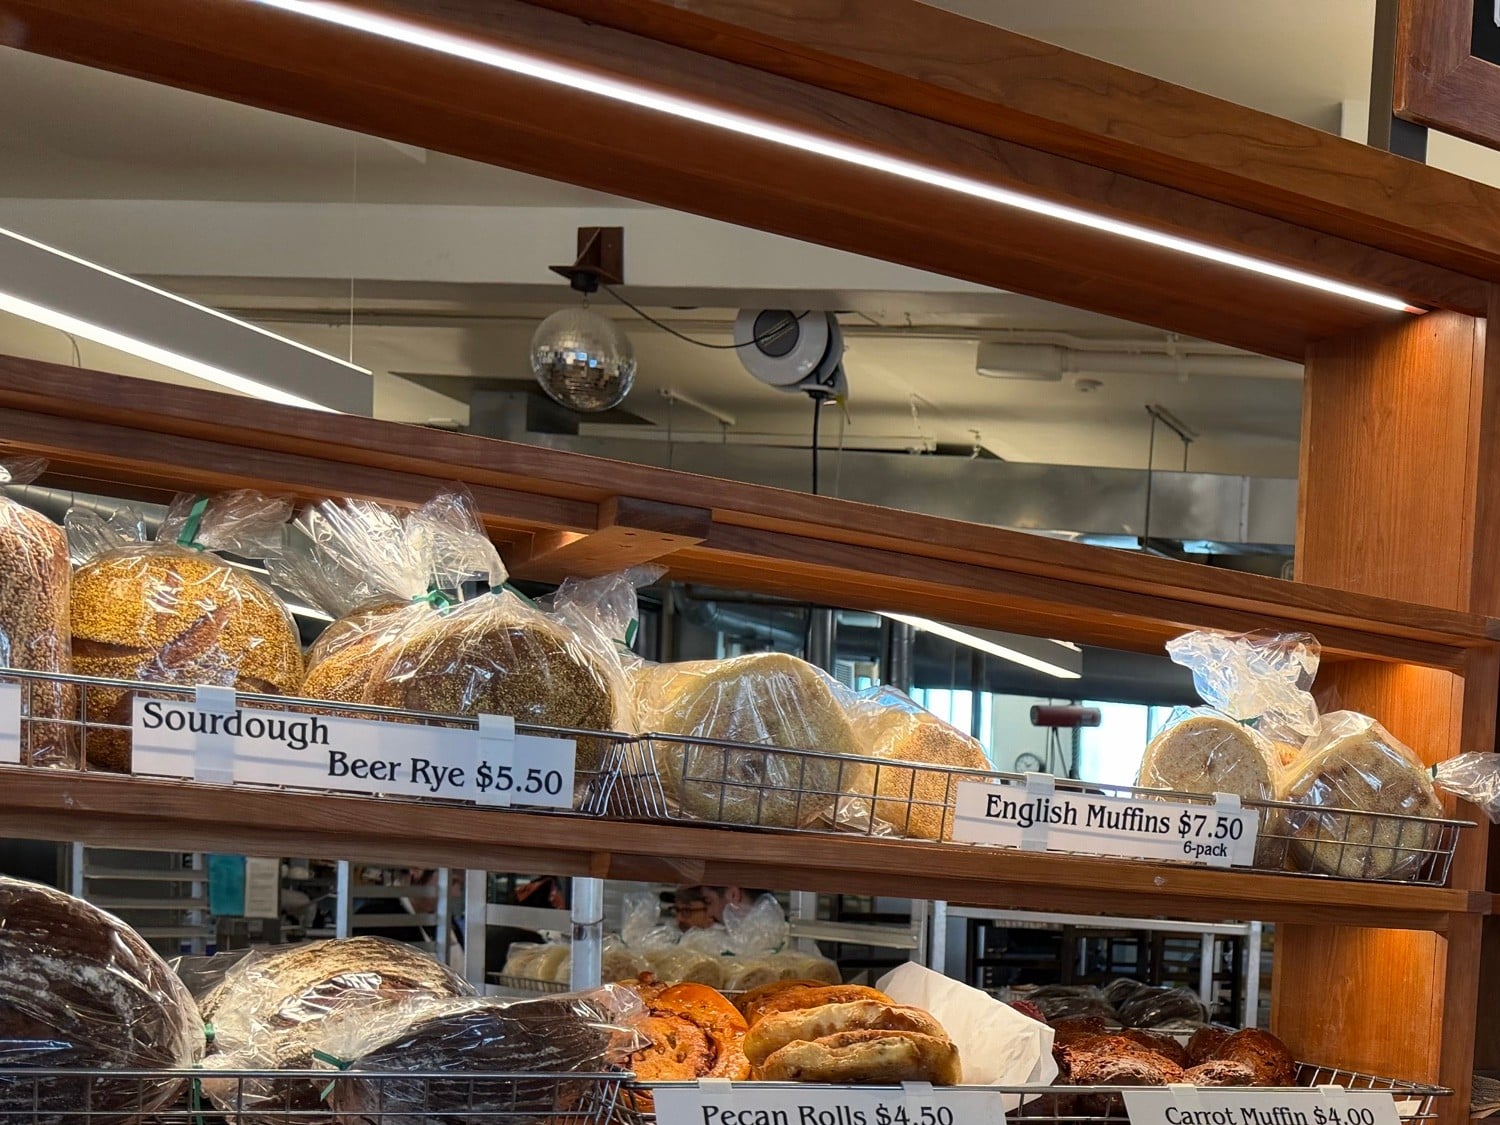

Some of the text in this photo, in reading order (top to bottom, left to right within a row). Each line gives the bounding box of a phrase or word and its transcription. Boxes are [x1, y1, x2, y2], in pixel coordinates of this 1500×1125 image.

[142, 702, 329, 750] Sourdough
[327, 751, 564, 795] Beer Rye $5.50
[985, 793, 1243, 841] English Muffins $7.50
[1183, 841, 1228, 859] 6-pack
[1165, 1107, 1237, 1125] Carrot
[1240, 1106, 1309, 1125] Muffin
